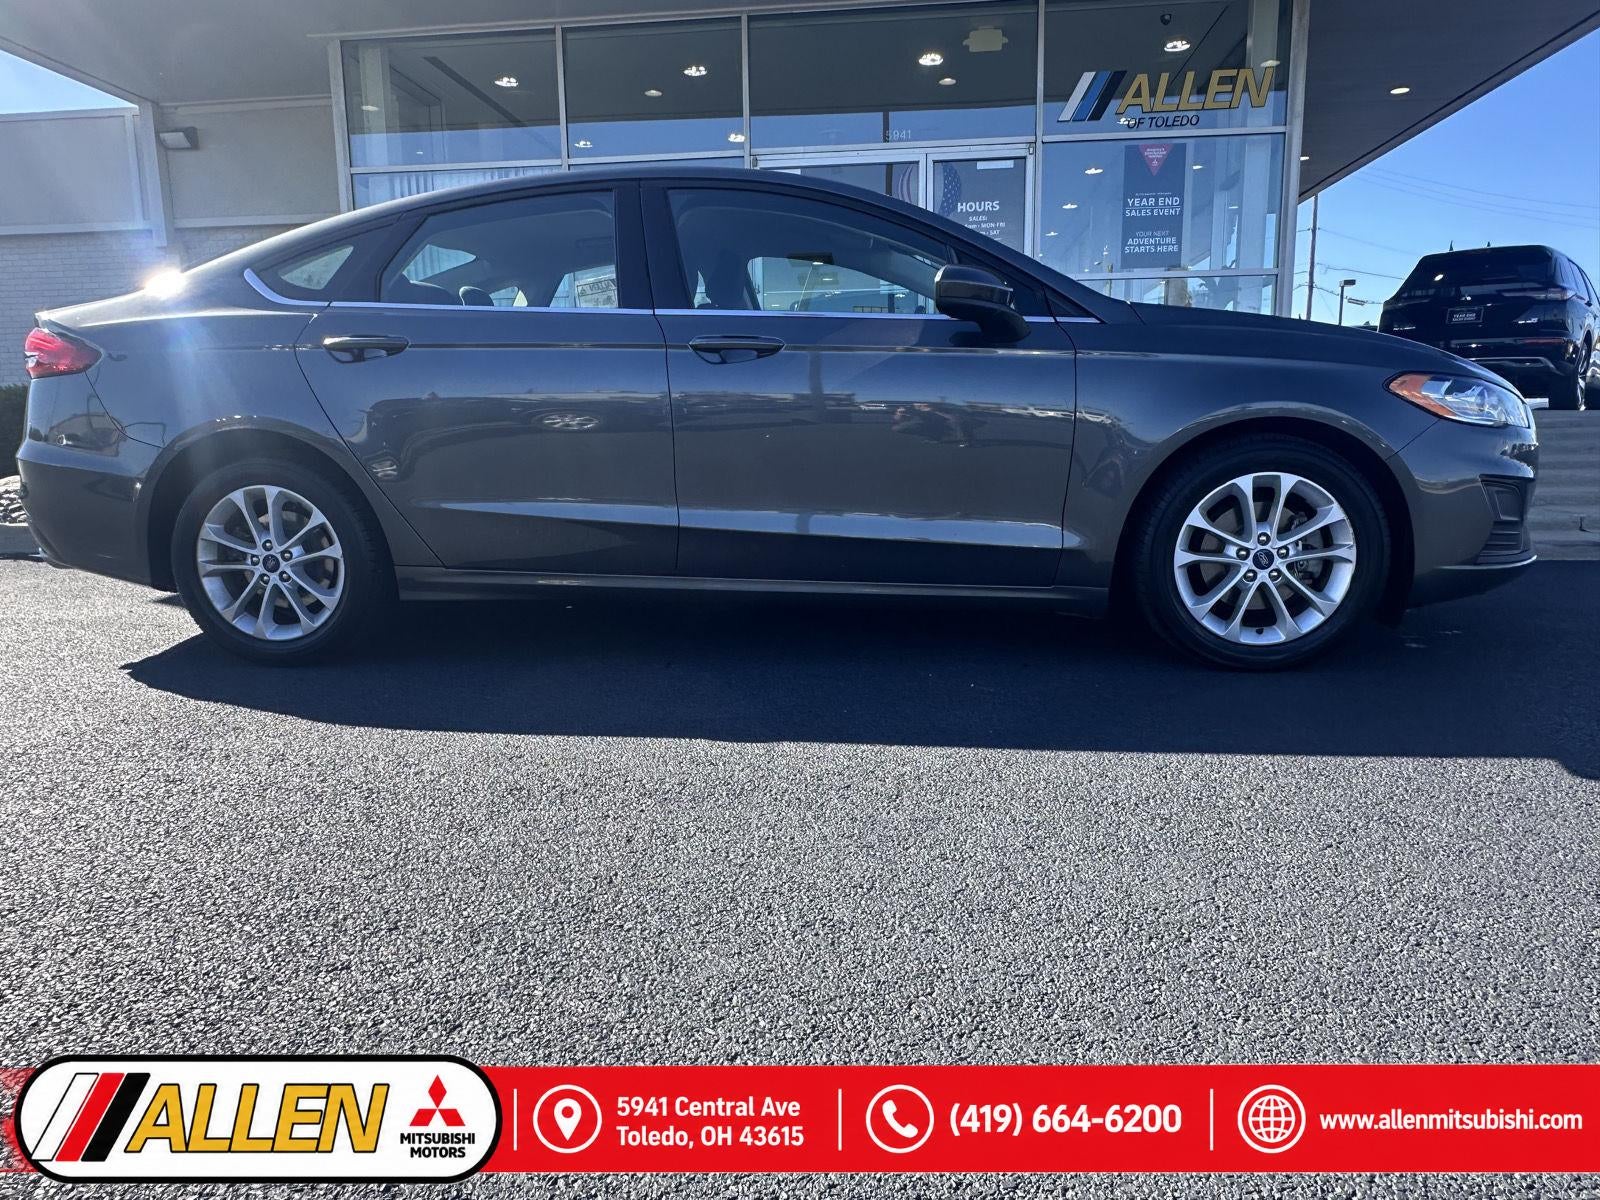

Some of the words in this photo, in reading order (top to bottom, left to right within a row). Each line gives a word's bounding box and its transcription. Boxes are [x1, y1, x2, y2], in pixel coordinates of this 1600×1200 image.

[1115, 66, 1275, 115] ALLEN
[1127, 117, 1145, 129] OF
[1149, 114, 1200, 128] TOLEDO
[957, 200, 1000, 213] HOURS
[1127, 197, 1155, 207] YEAR
[1158, 196, 1180, 206] END
[1125, 209, 1151, 217] SALES
[1153, 207, 1181, 216] EVENT
[1127, 236, 1177, 246] ADVENTURE
[1124, 246, 1155, 254] STARTS
[1157, 244, 1179, 253] HERE
